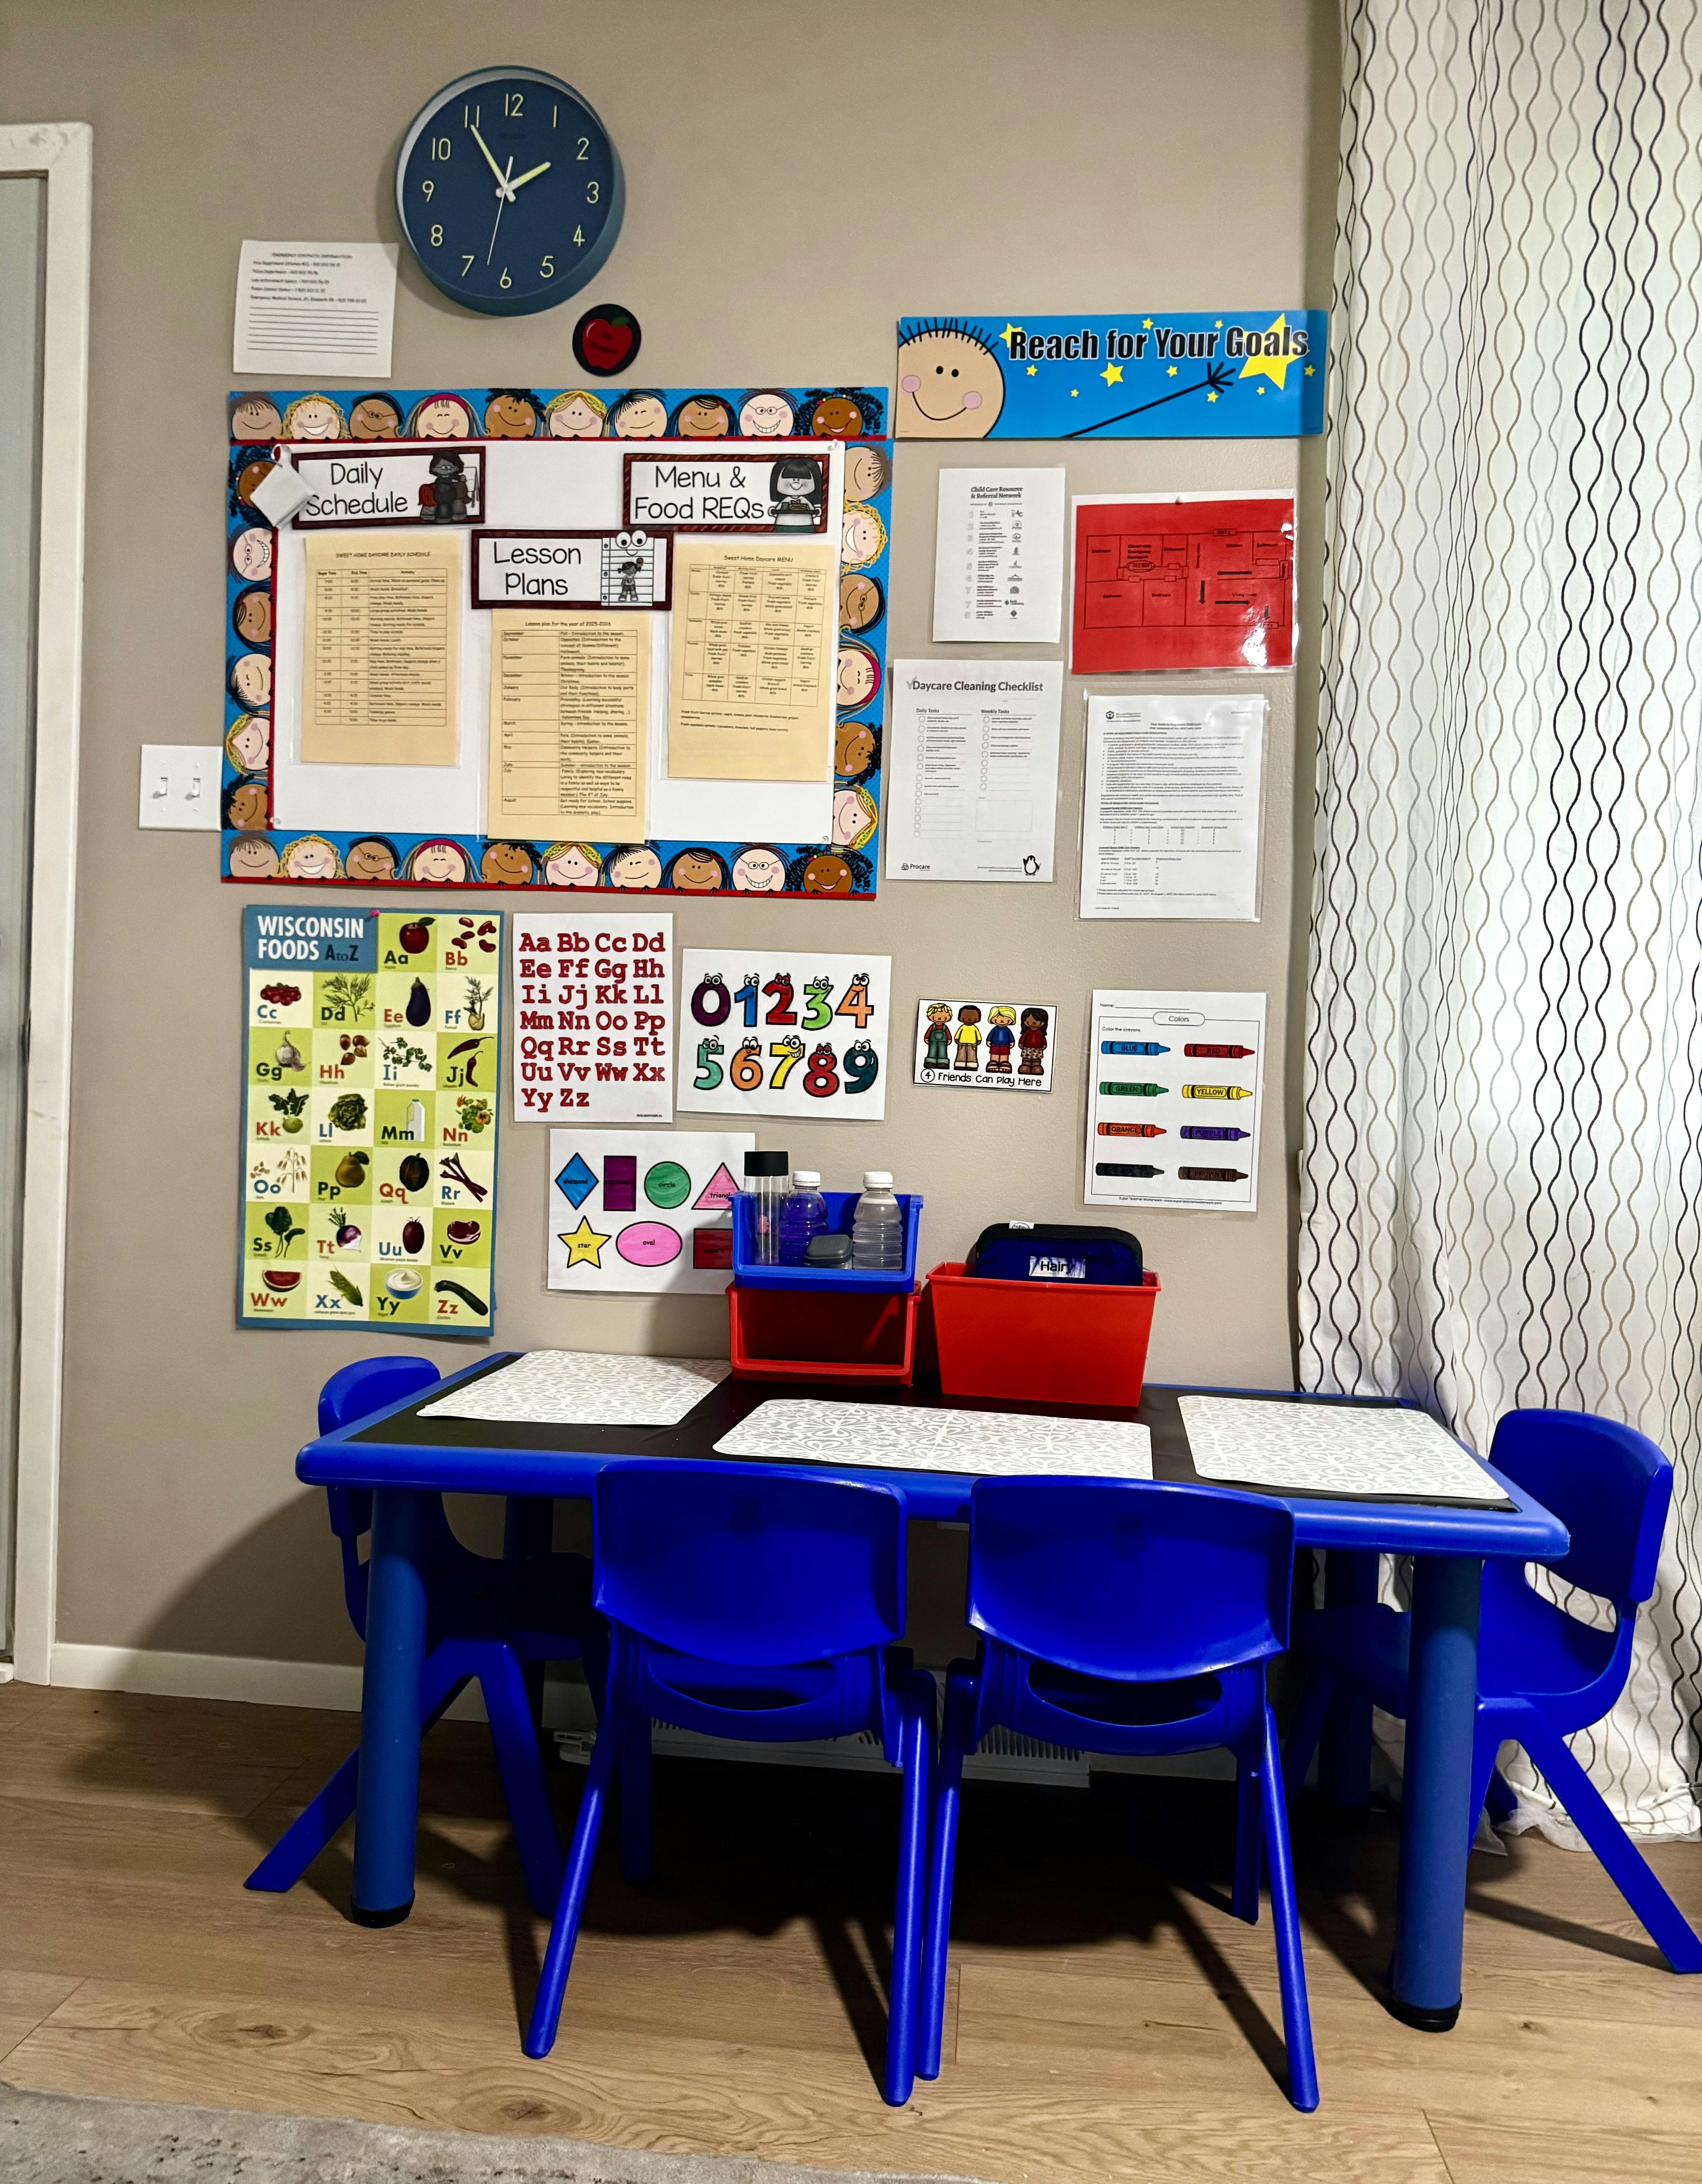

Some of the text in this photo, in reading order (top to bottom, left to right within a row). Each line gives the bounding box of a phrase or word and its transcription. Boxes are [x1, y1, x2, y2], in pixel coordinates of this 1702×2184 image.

[505, 94, 523, 116] 12
[463, 105, 480, 128] 11
[553, 105, 557, 128] 1
[432, 138, 450, 160] 10
[576, 137, 589, 160] 2
[423, 181, 434, 202] 9
[587, 181, 599, 203] 3
[431, 225, 443, 246] 8
[573, 225, 585, 247] 4
[462, 255, 474, 277] 7
[540, 256, 553, 278] 5
[500, 267, 511, 288] 6
[1008, 326, 1309, 361] Reach for Your Goals
[331, 462, 383, 489] Daily
[656, 466, 746, 488] Menu &
[306, 491, 408, 516] Schedule
[635, 497, 764, 519] Food REQs
[494, 542, 581, 564] Lesson
[506, 573, 568, 595] Plans
[913, 681, 1043, 692] Daycare Cleaning Checklist
[257, 915, 364, 938] WISCONSIN
[259, 939, 319, 960] FOODS
[519, 932, 665, 952] Aa Bb Cc Dd
[384, 950, 409, 965] Aa
[445, 951, 468, 966] Bb
[520, 958, 664, 984] Ee Ff Gg Hh
[522, 984, 663, 1010] Ii Jj Kk Ll
[691, 975, 874, 1031] 0 1 2 3 4
[257, 1005, 277, 1019] Cc
[321, 1006, 345, 1022] Dd
[384, 1009, 403, 1024] Ee
[445, 1009, 461, 1024] Ff
[520, 1011, 665, 1036] Mm Nn Oo Pp
[521, 1036, 665, 1061] Qq Rr Ss Tt
[256, 1062, 282, 1081] Gg
[320, 1064, 345, 1079] Hh
[383, 1064, 397, 1081] Ii
[446, 1066, 465, 1087] Jj
[521, 1063, 665, 1081] Uu Vv Ww Xx
[693, 1037, 878, 1097] 5 6 7 8 9
[939, 1073, 971, 1082] Friends
[997, 1076, 1015, 1087] Play
[1018, 1077, 1042, 1086] Here
[522, 1089, 589, 1112] Yy Zz
[256, 1121, 281, 1136] Kk
[319, 1122, 333, 1138] Ll
[382, 1126, 414, 1141] Mm
[443, 1128, 468, 1142] Nn
[254, 1179, 281, 1194] Oo
[318, 1181, 341, 1200] Pp
[379, 1183, 409, 1204] Qq
[441, 1186, 460, 1200] Rr
[253, 1237, 272, 1252] Ss
[317, 1240, 335, 1255] Tt
[379, 1242, 402, 1257] Uu
[440, 1244, 463, 1259] Vv
[1041, 1261, 1075, 1274] Hairy
[251, 1292, 288, 1307] Ww
[315, 1294, 341, 1309] Xx
[376, 1297, 401, 1316] Yy
[437, 1299, 458, 1315] Zz
